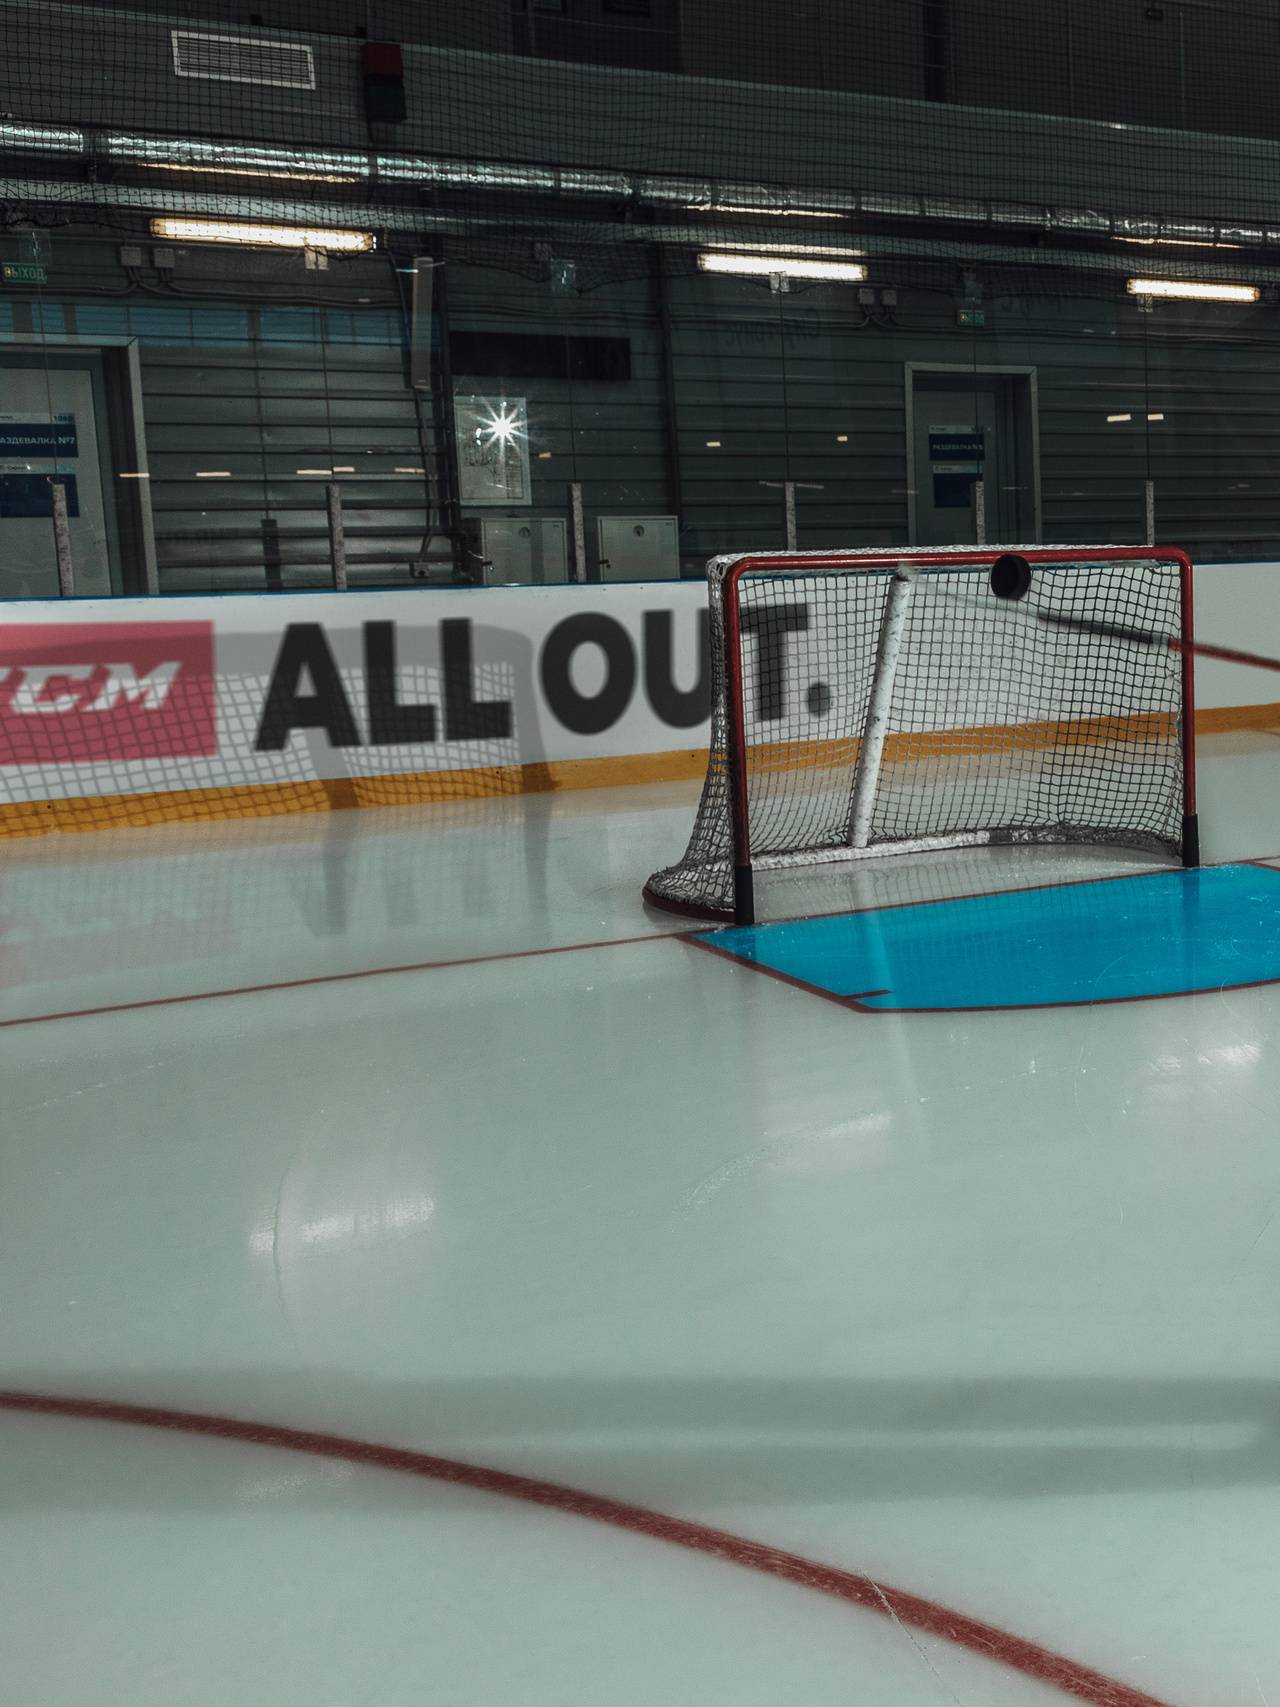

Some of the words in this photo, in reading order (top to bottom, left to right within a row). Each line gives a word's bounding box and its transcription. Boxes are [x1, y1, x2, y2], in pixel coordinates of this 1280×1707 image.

[4, 266, 45, 281] ВЫХОД
[0, 660, 183, 715] CM
[254, 618, 512, 752] ALL
